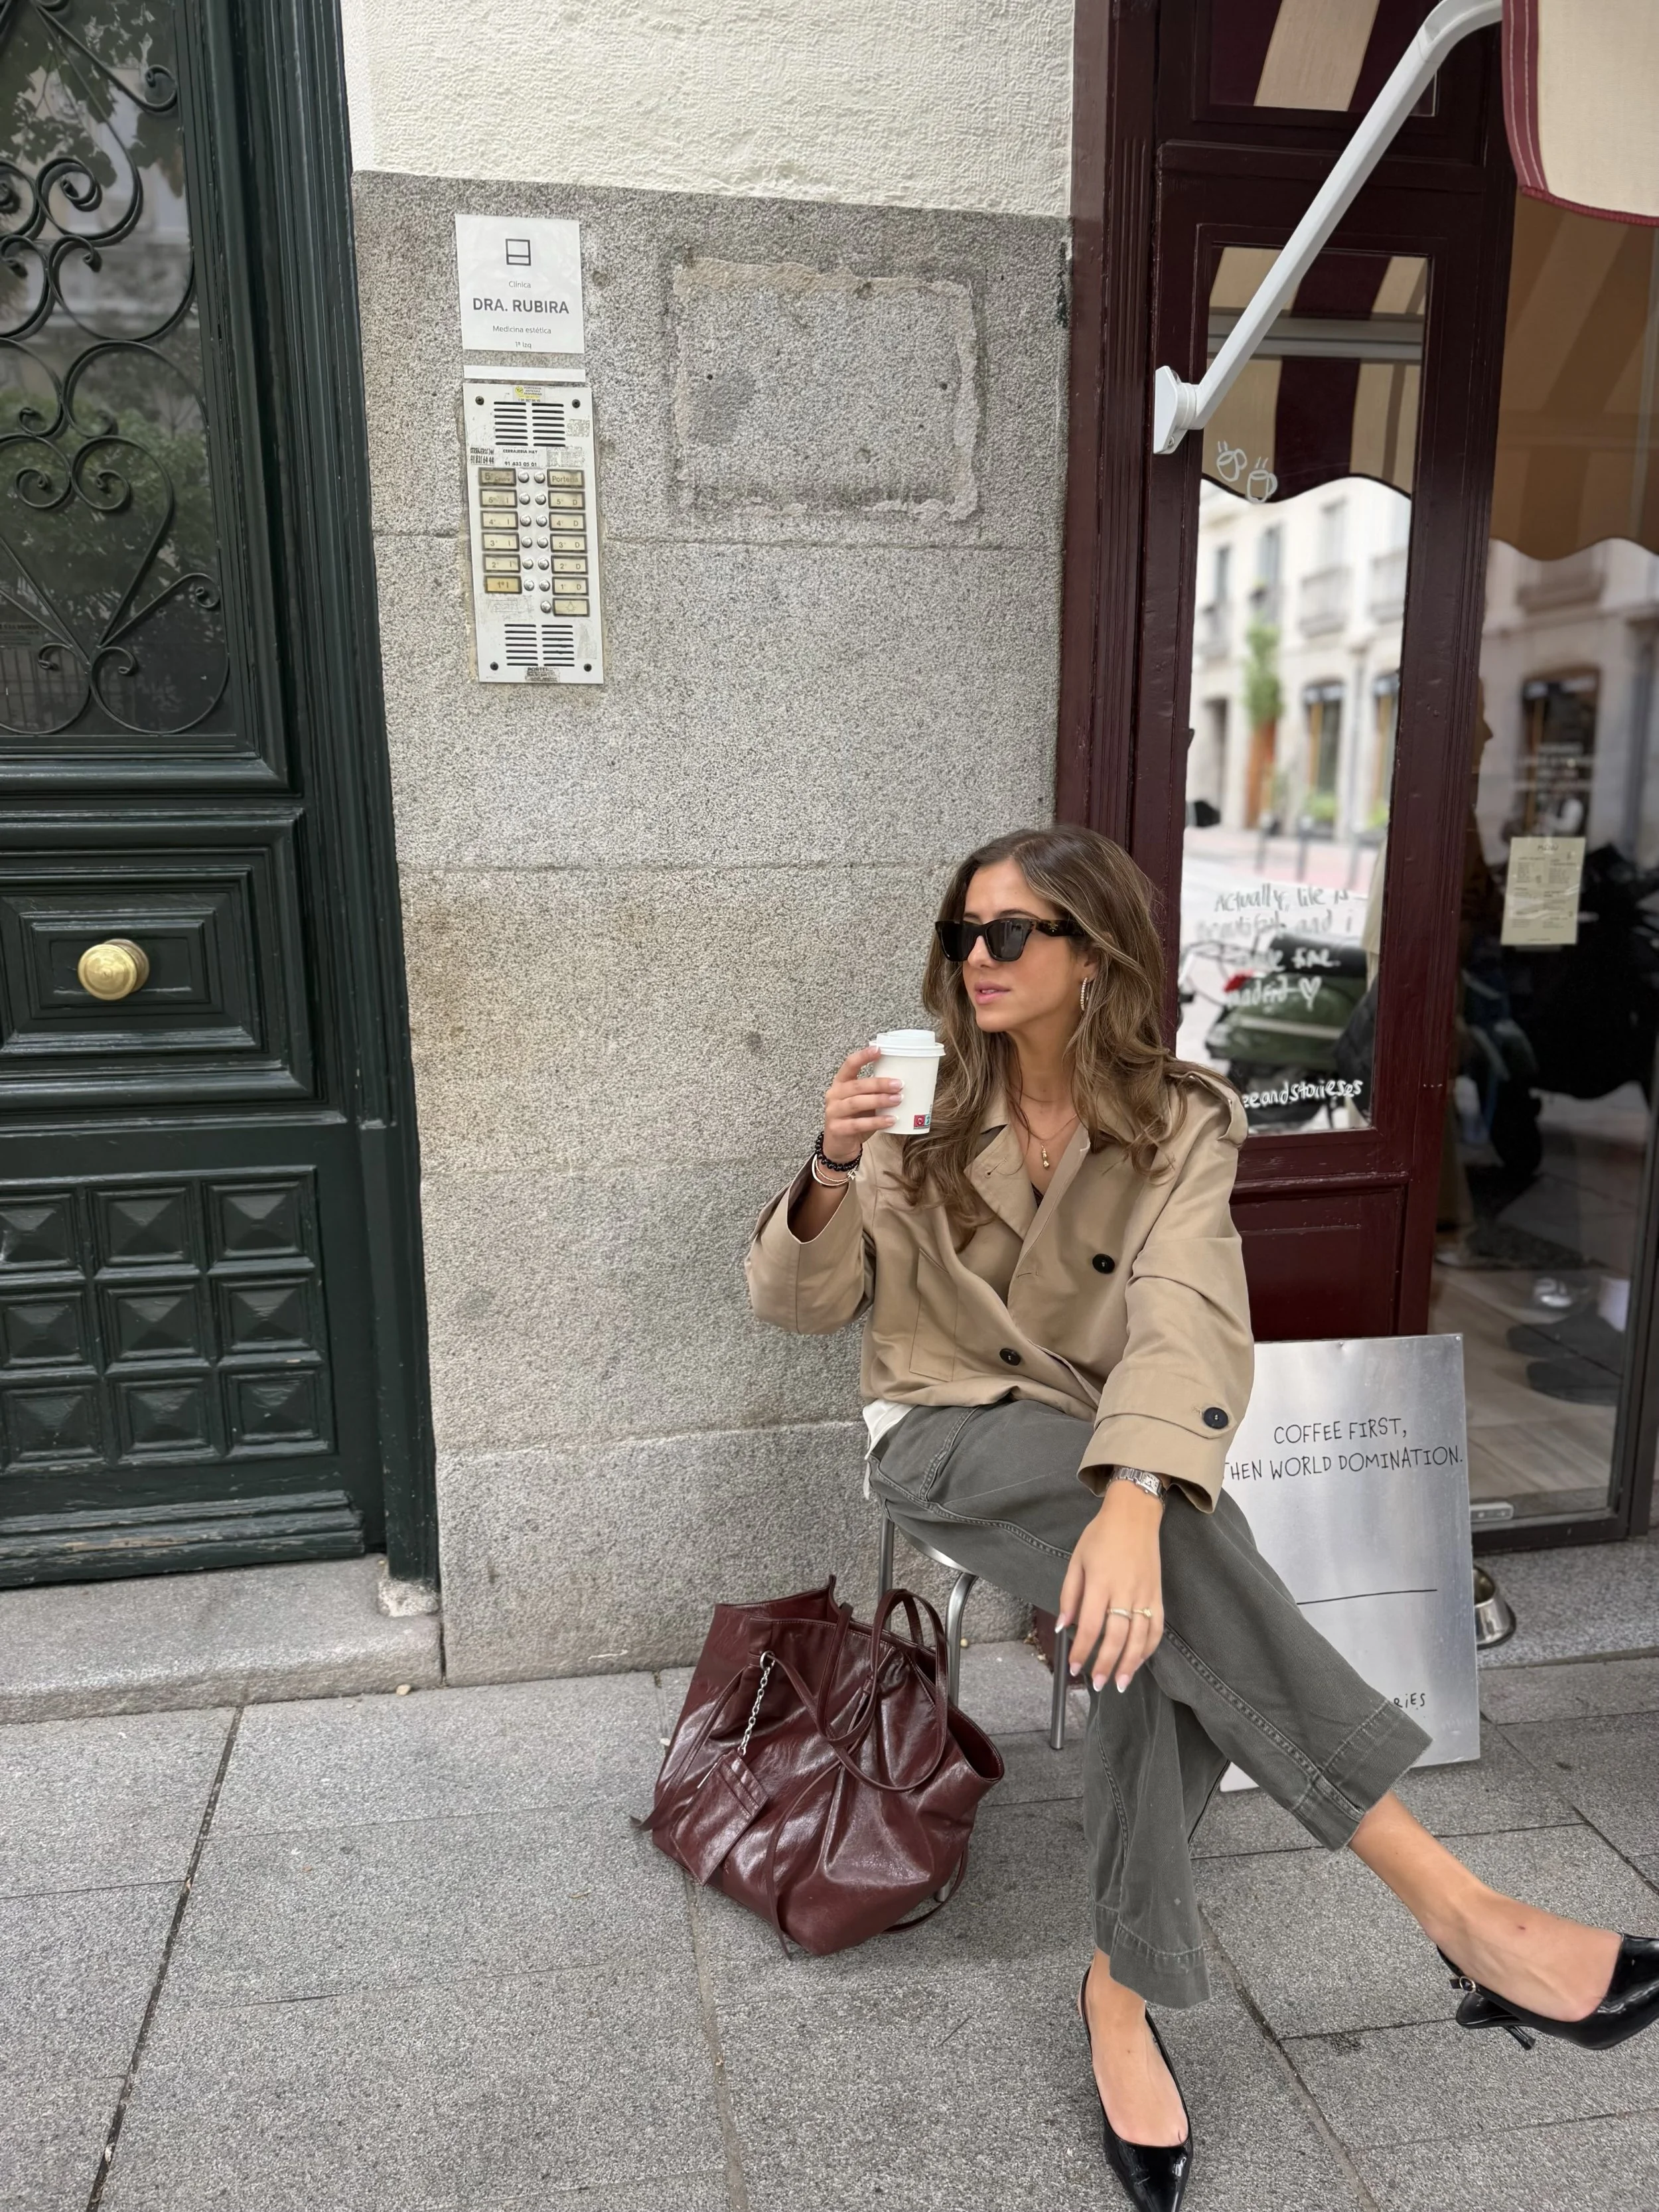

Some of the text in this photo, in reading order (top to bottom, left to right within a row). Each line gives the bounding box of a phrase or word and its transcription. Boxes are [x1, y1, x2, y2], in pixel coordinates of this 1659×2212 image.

[472, 298, 570, 314] DRA. RUBIRA
[1273, 1418, 1407, 1444] COFFEE FIRST,
[1269, 1455, 1332, 1481] WORLD
[1338, 1444, 1464, 1473] DOMINATION.
